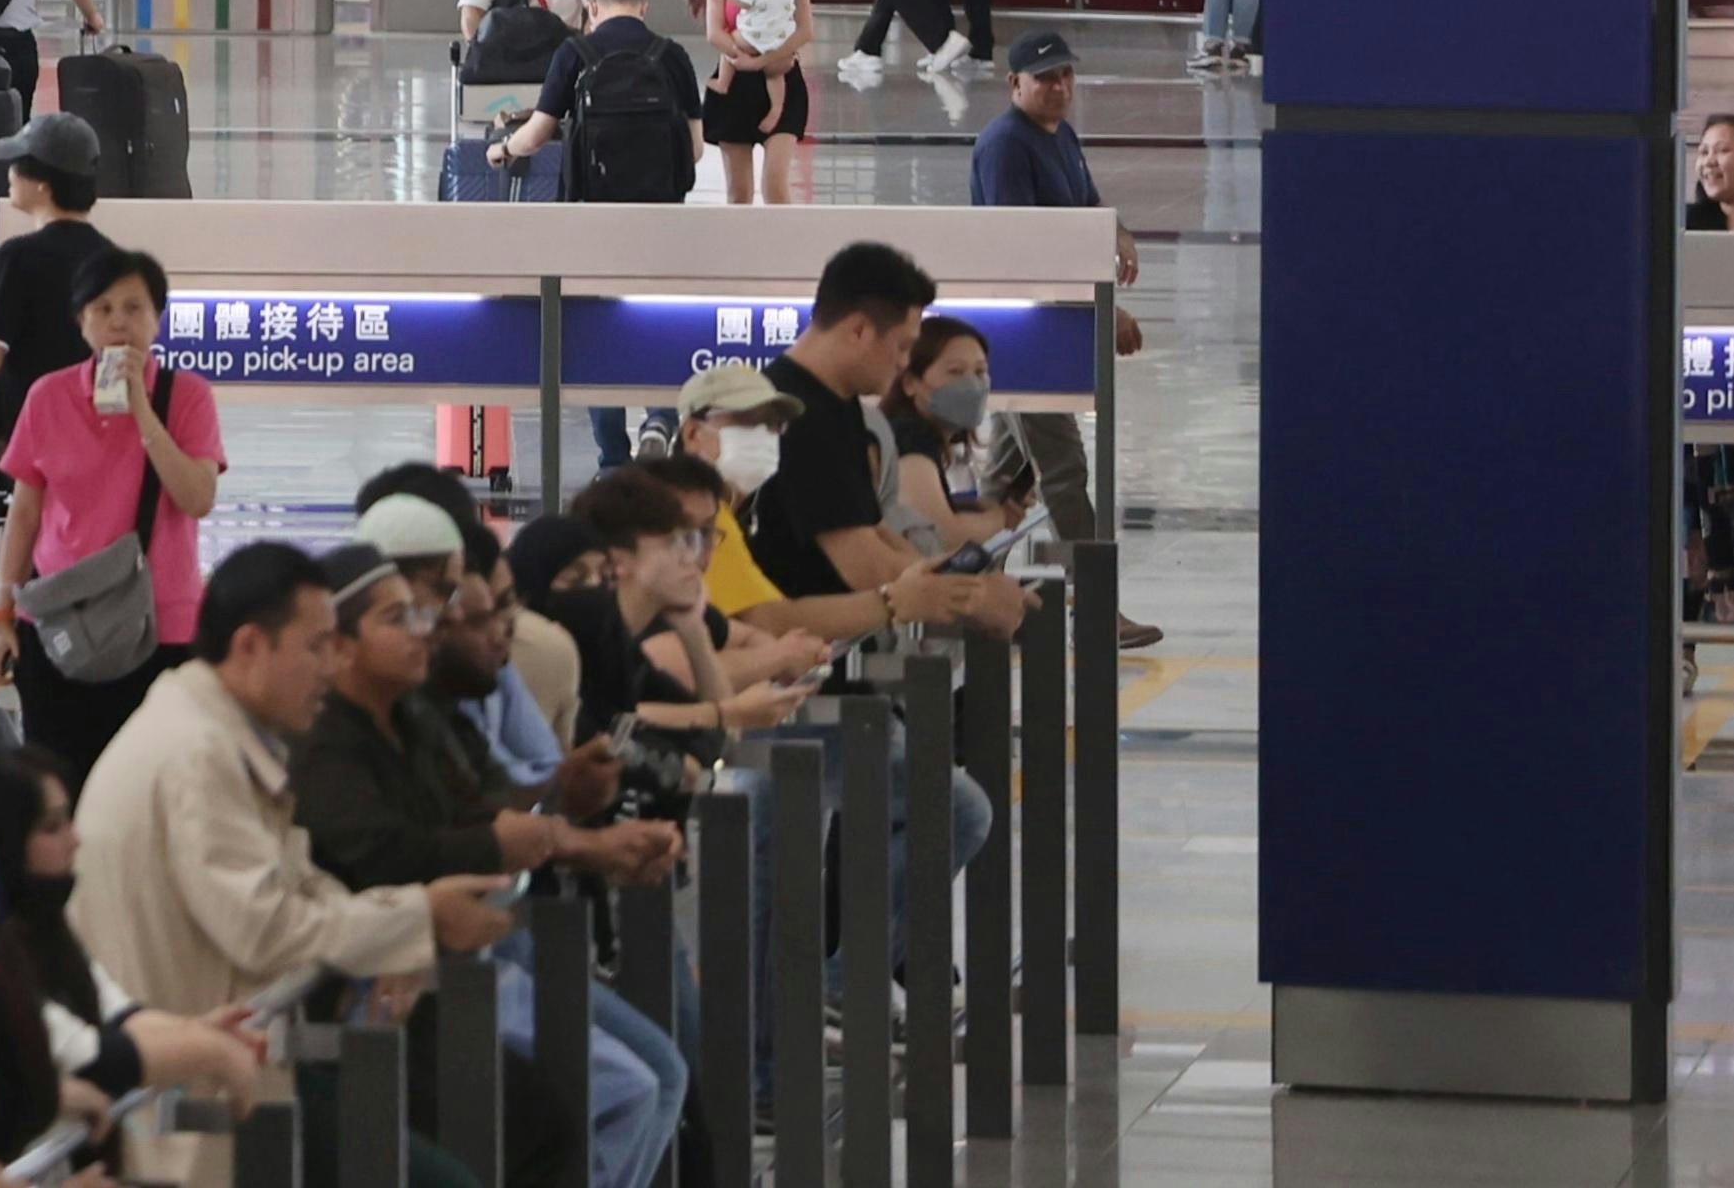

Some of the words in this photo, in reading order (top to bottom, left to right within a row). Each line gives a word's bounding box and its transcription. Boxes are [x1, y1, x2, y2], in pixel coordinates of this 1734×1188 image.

[169, 301, 391, 342] 團體接待區
[242, 346, 344, 377] pick-up
[352, 353, 415, 373] area
